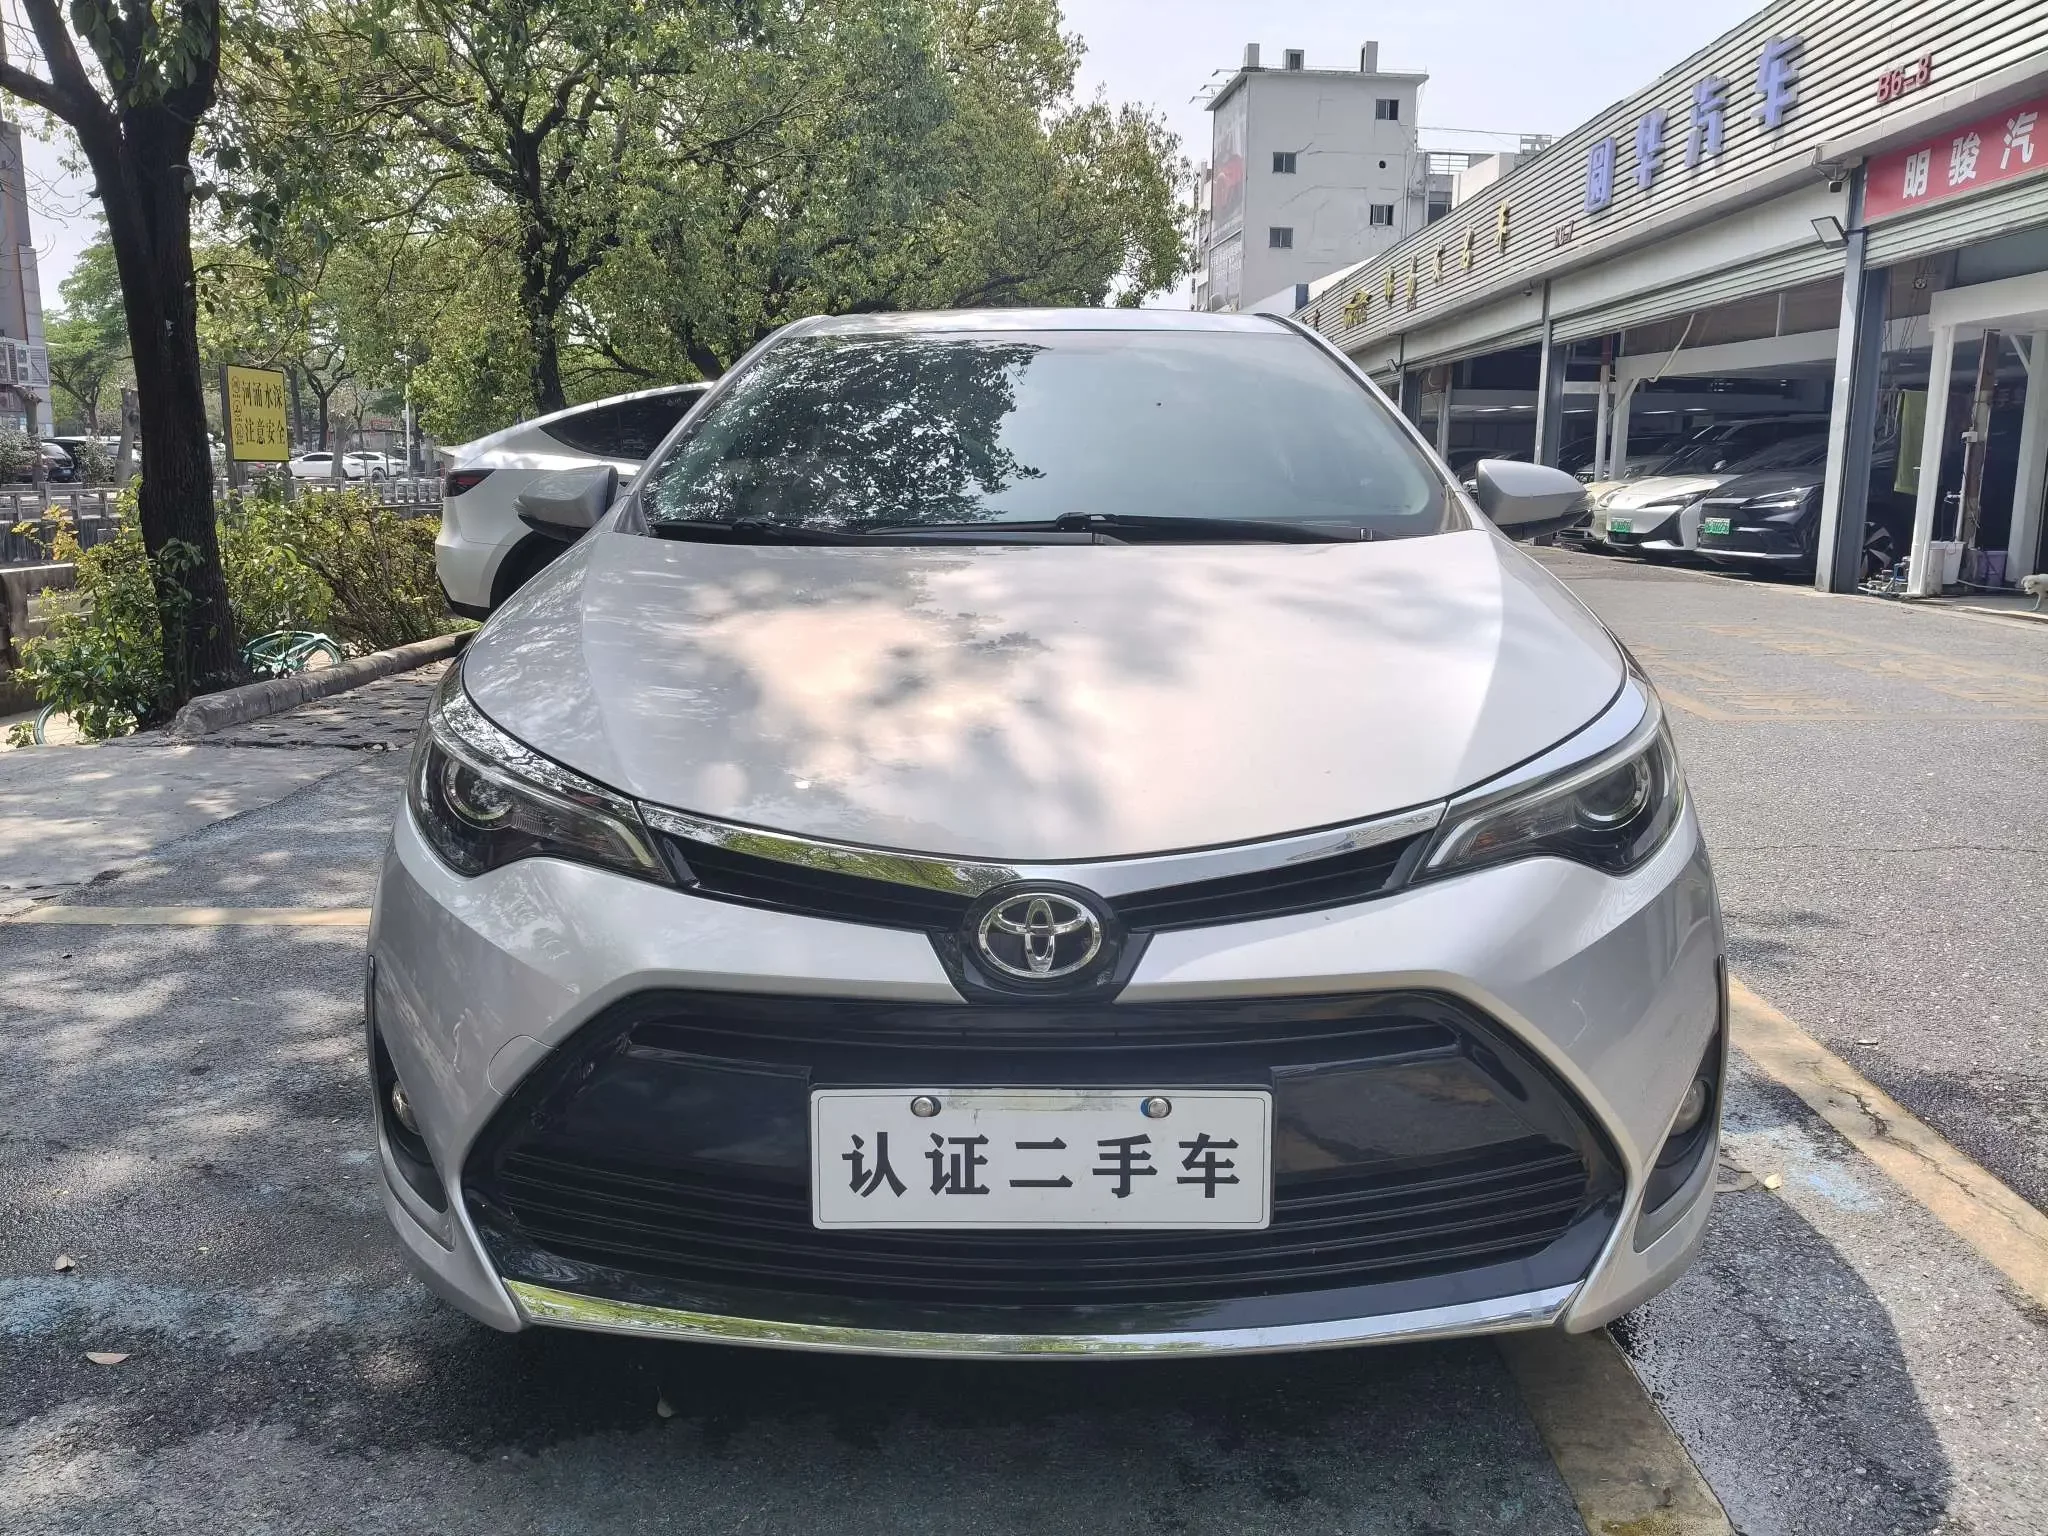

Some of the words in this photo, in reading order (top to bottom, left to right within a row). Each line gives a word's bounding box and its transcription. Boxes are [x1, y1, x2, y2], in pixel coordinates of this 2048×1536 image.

[1877, 53, 1933, 104] B6-8
[1903, 111, 2039, 199] 明骏汽
[242, 380, 283, 409] 河涌水深
[244, 417, 286, 445] 注意安全
[842, 1131, 1241, 1199] 认证二手车
